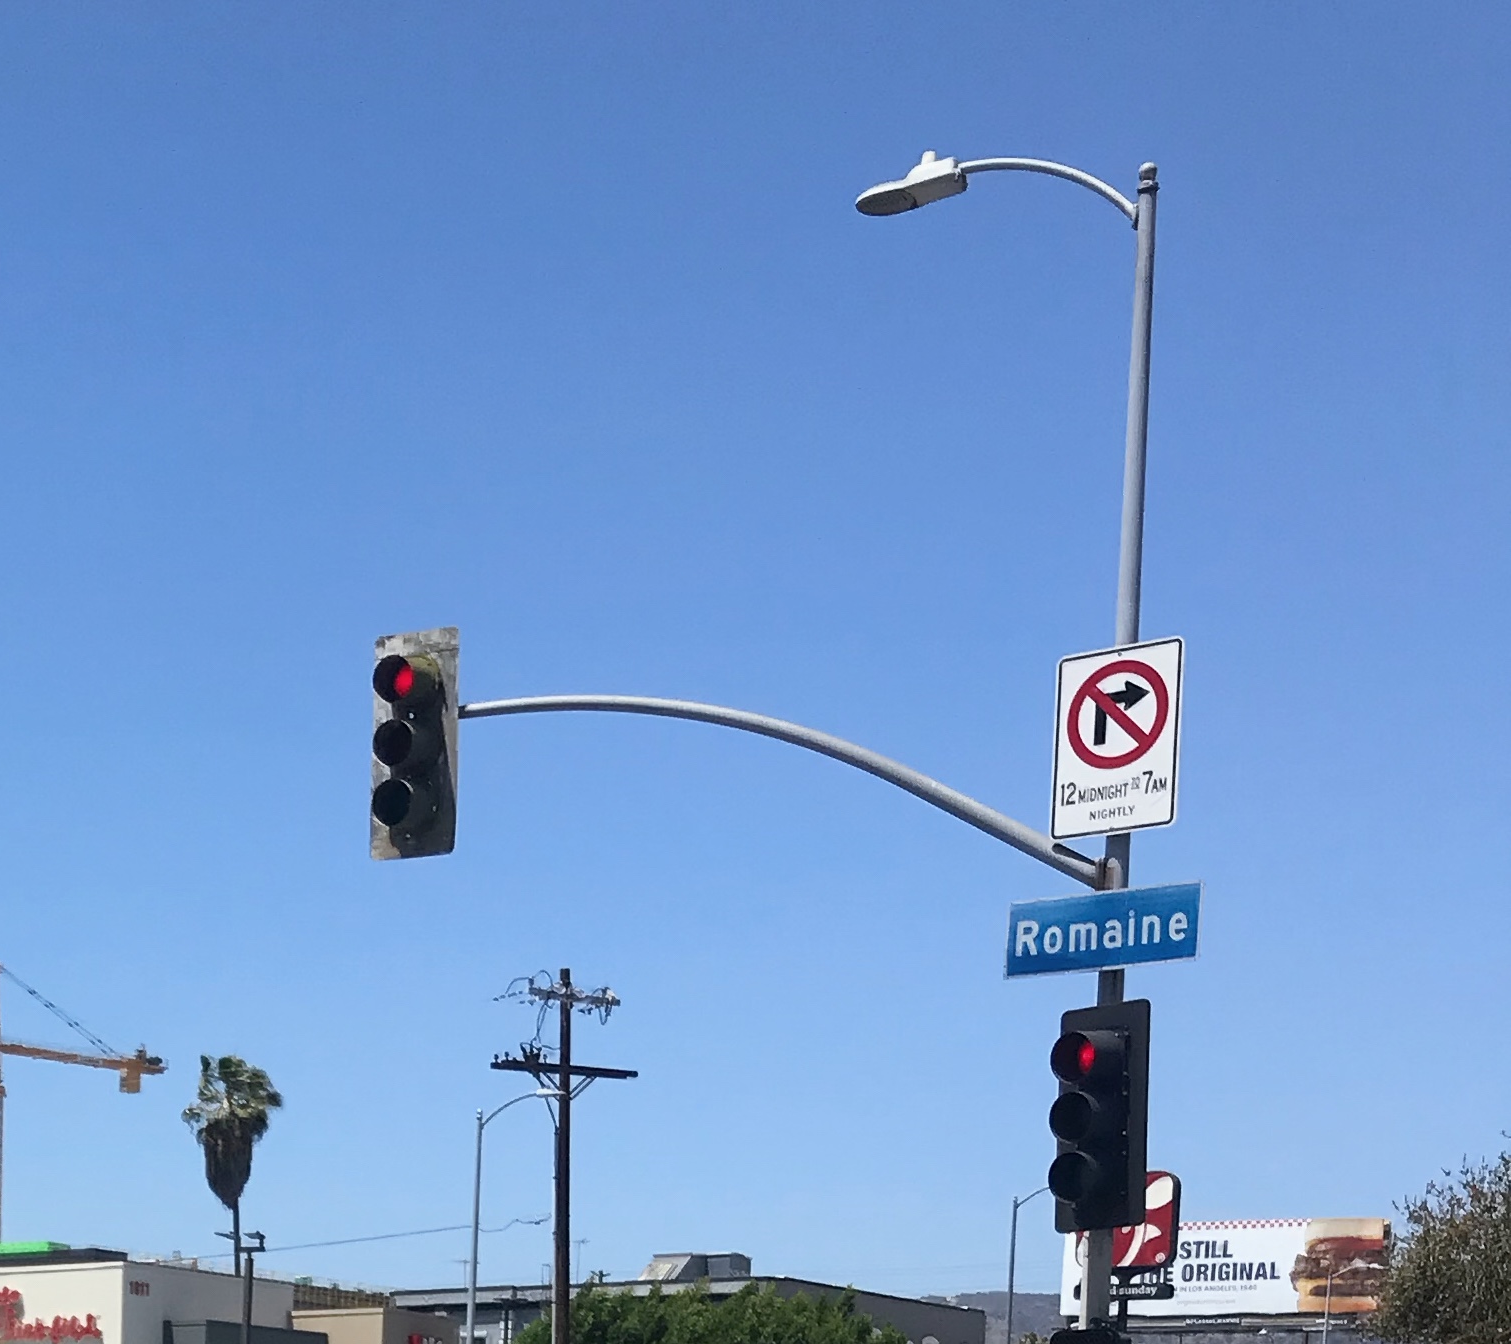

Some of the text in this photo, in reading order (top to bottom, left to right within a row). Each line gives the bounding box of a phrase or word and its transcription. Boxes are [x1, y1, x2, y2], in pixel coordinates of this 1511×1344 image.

[1060, 782, 1077, 806] 12
[1078, 782, 1128, 804] MIDNIGHT
[1089, 805, 1136, 820] NIGHTLY
[1014, 909, 1188, 958] Romaine
[1179, 1240, 1233, 1260] STILL
[1181, 1261, 1281, 1283] ORIGINAL
[1117, 1285, 1158, 1297] sunday
